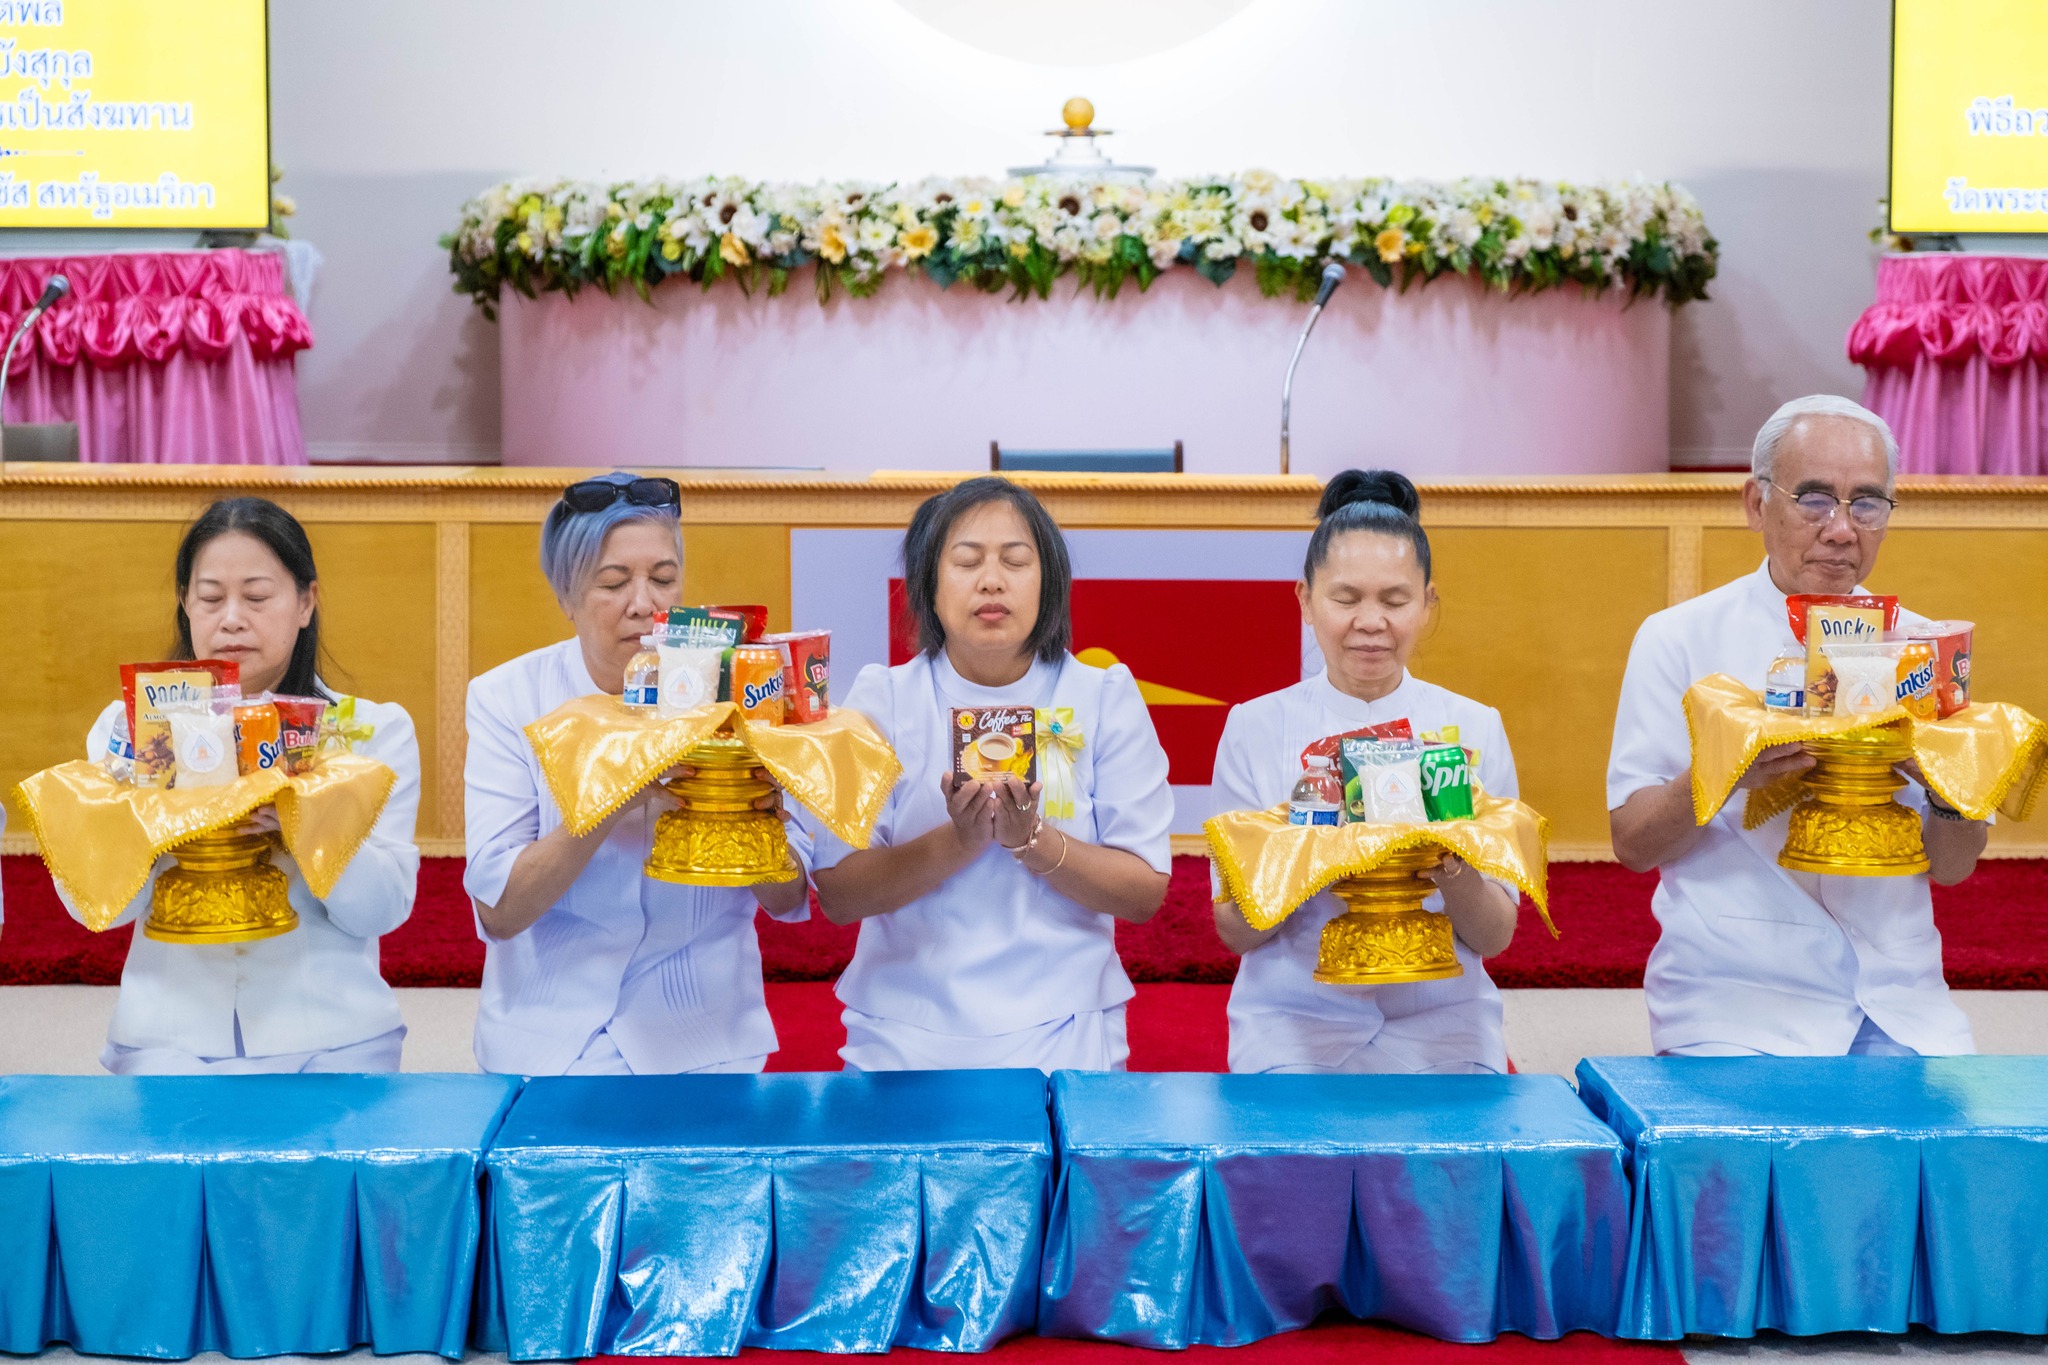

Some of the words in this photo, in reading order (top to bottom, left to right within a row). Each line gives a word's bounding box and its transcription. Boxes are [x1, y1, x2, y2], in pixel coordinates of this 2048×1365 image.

[0, 87, 192, 129] เป็นสังฆทาน
[37, 172, 215, 218] สหรัฐอเมริกา
[1894, 659, 1935, 702] unkist
[979, 708, 1018, 732] Coffee
